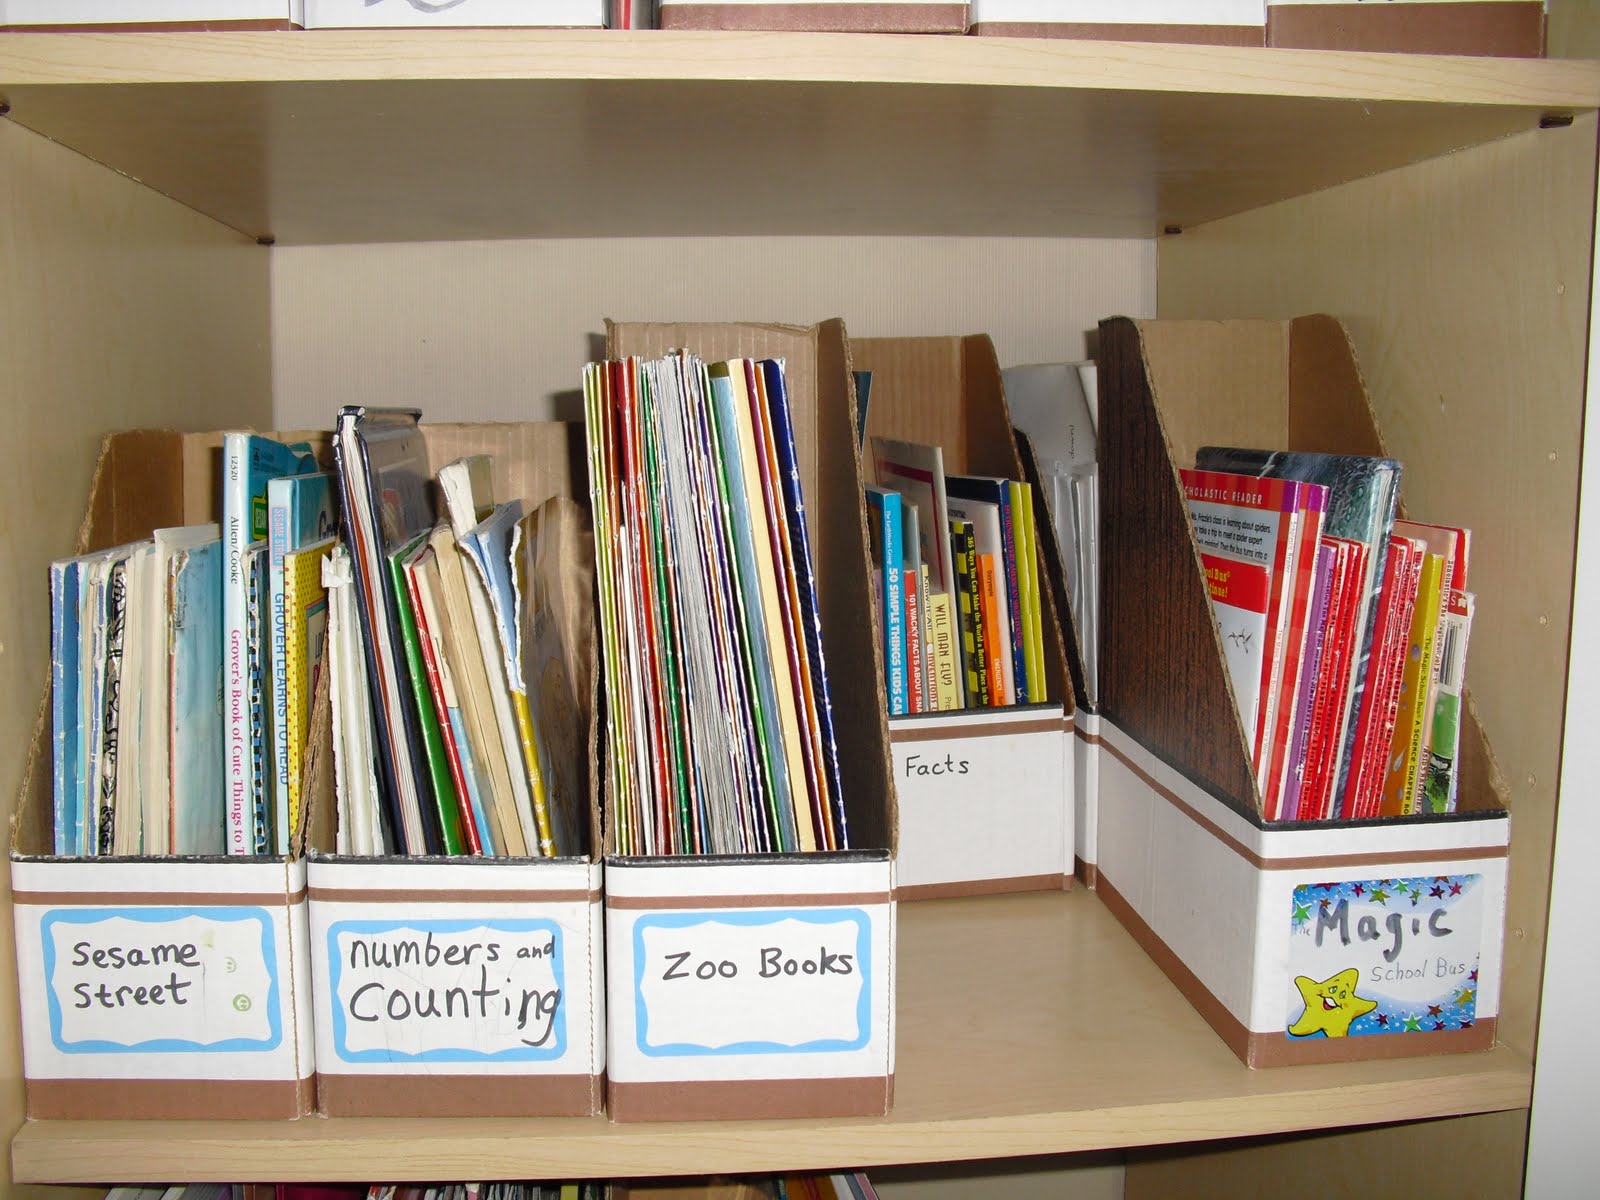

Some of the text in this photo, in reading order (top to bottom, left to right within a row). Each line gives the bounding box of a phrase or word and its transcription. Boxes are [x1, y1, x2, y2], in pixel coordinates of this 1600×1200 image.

[231, 455, 239, 481] 12320
[1185, 486, 1263, 504] CHOLASTIC READER
[273, 509, 284, 537] SESAME
[1242, 521, 1254, 530] about
[228, 516, 241, 585] Allen/Cooke
[888, 567, 899, 582] 50
[1443, 560, 1453, 602] Scholastic's
[888, 584, 901, 623] SIMPLE
[922, 576, 934, 630] Know-It-All
[1210, 583, 1228, 598] tinue!
[274, 593, 288, 654] GROVER
[909, 608, 919, 638] WACKY
[934, 604, 947, 628] WILL
[968, 550, 976, 566] Ways
[978, 649, 986, 667] Better
[230, 630, 242, 685] Grover's
[889, 625, 903, 666] THINGS
[911, 639, 921, 665] FACTS
[937, 632, 950, 656] MAN
[1420, 652, 1430, 674] Magic
[275, 659, 289, 717] LEARNS
[891, 668, 903, 694] KIDS
[913, 666, 923, 694] ABOUT
[1417, 675, 1427, 700] School
[231, 689, 243, 723] Book
[232, 727, 243, 742] of
[232, 745, 244, 776] Cute
[277, 746, 289, 785] READ
[906, 754, 969, 777] Facts
[231, 779, 245, 826] Things
[234, 830, 245, 843] to
[1315, 898, 1453, 963] Magic
[72, 942, 200, 969] Sesame
[351, 931, 555, 968] numbers and
[662, 946, 853, 980] Zoo Books
[1370, 957, 1466, 982] School Bus
[74, 972, 192, 1008] Street
[350, 964, 562, 1046] Counting
